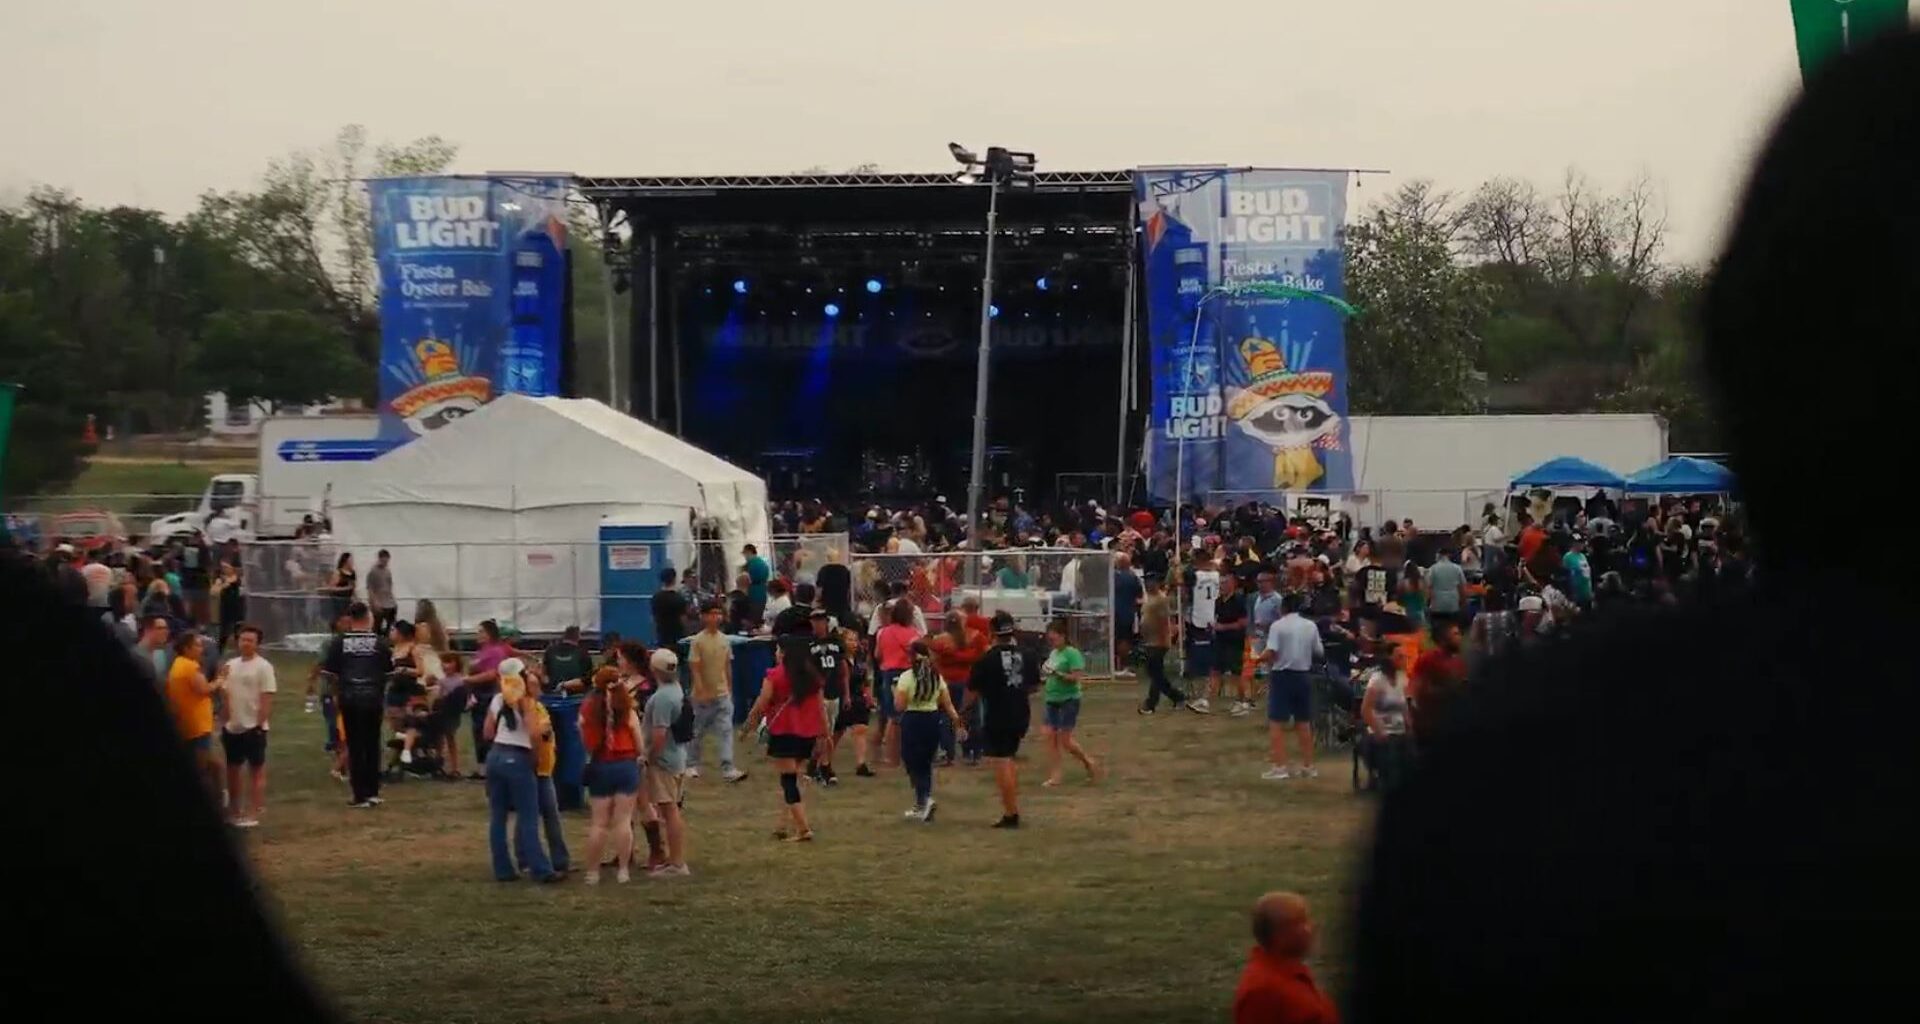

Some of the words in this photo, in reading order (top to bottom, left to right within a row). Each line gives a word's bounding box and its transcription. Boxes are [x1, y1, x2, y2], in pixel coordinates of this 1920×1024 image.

[408, 196, 484, 220] BUD
[1231, 188, 1309, 215] BUD
[396, 220, 499, 248] LIGHT
[401, 263, 454, 279] Fiesta
[401, 280, 457, 300] Oyster
[1283, 274, 1324, 292] Bake
[1171, 396, 1222, 417] BUD
[1165, 415, 1228, 439] LIGHT
